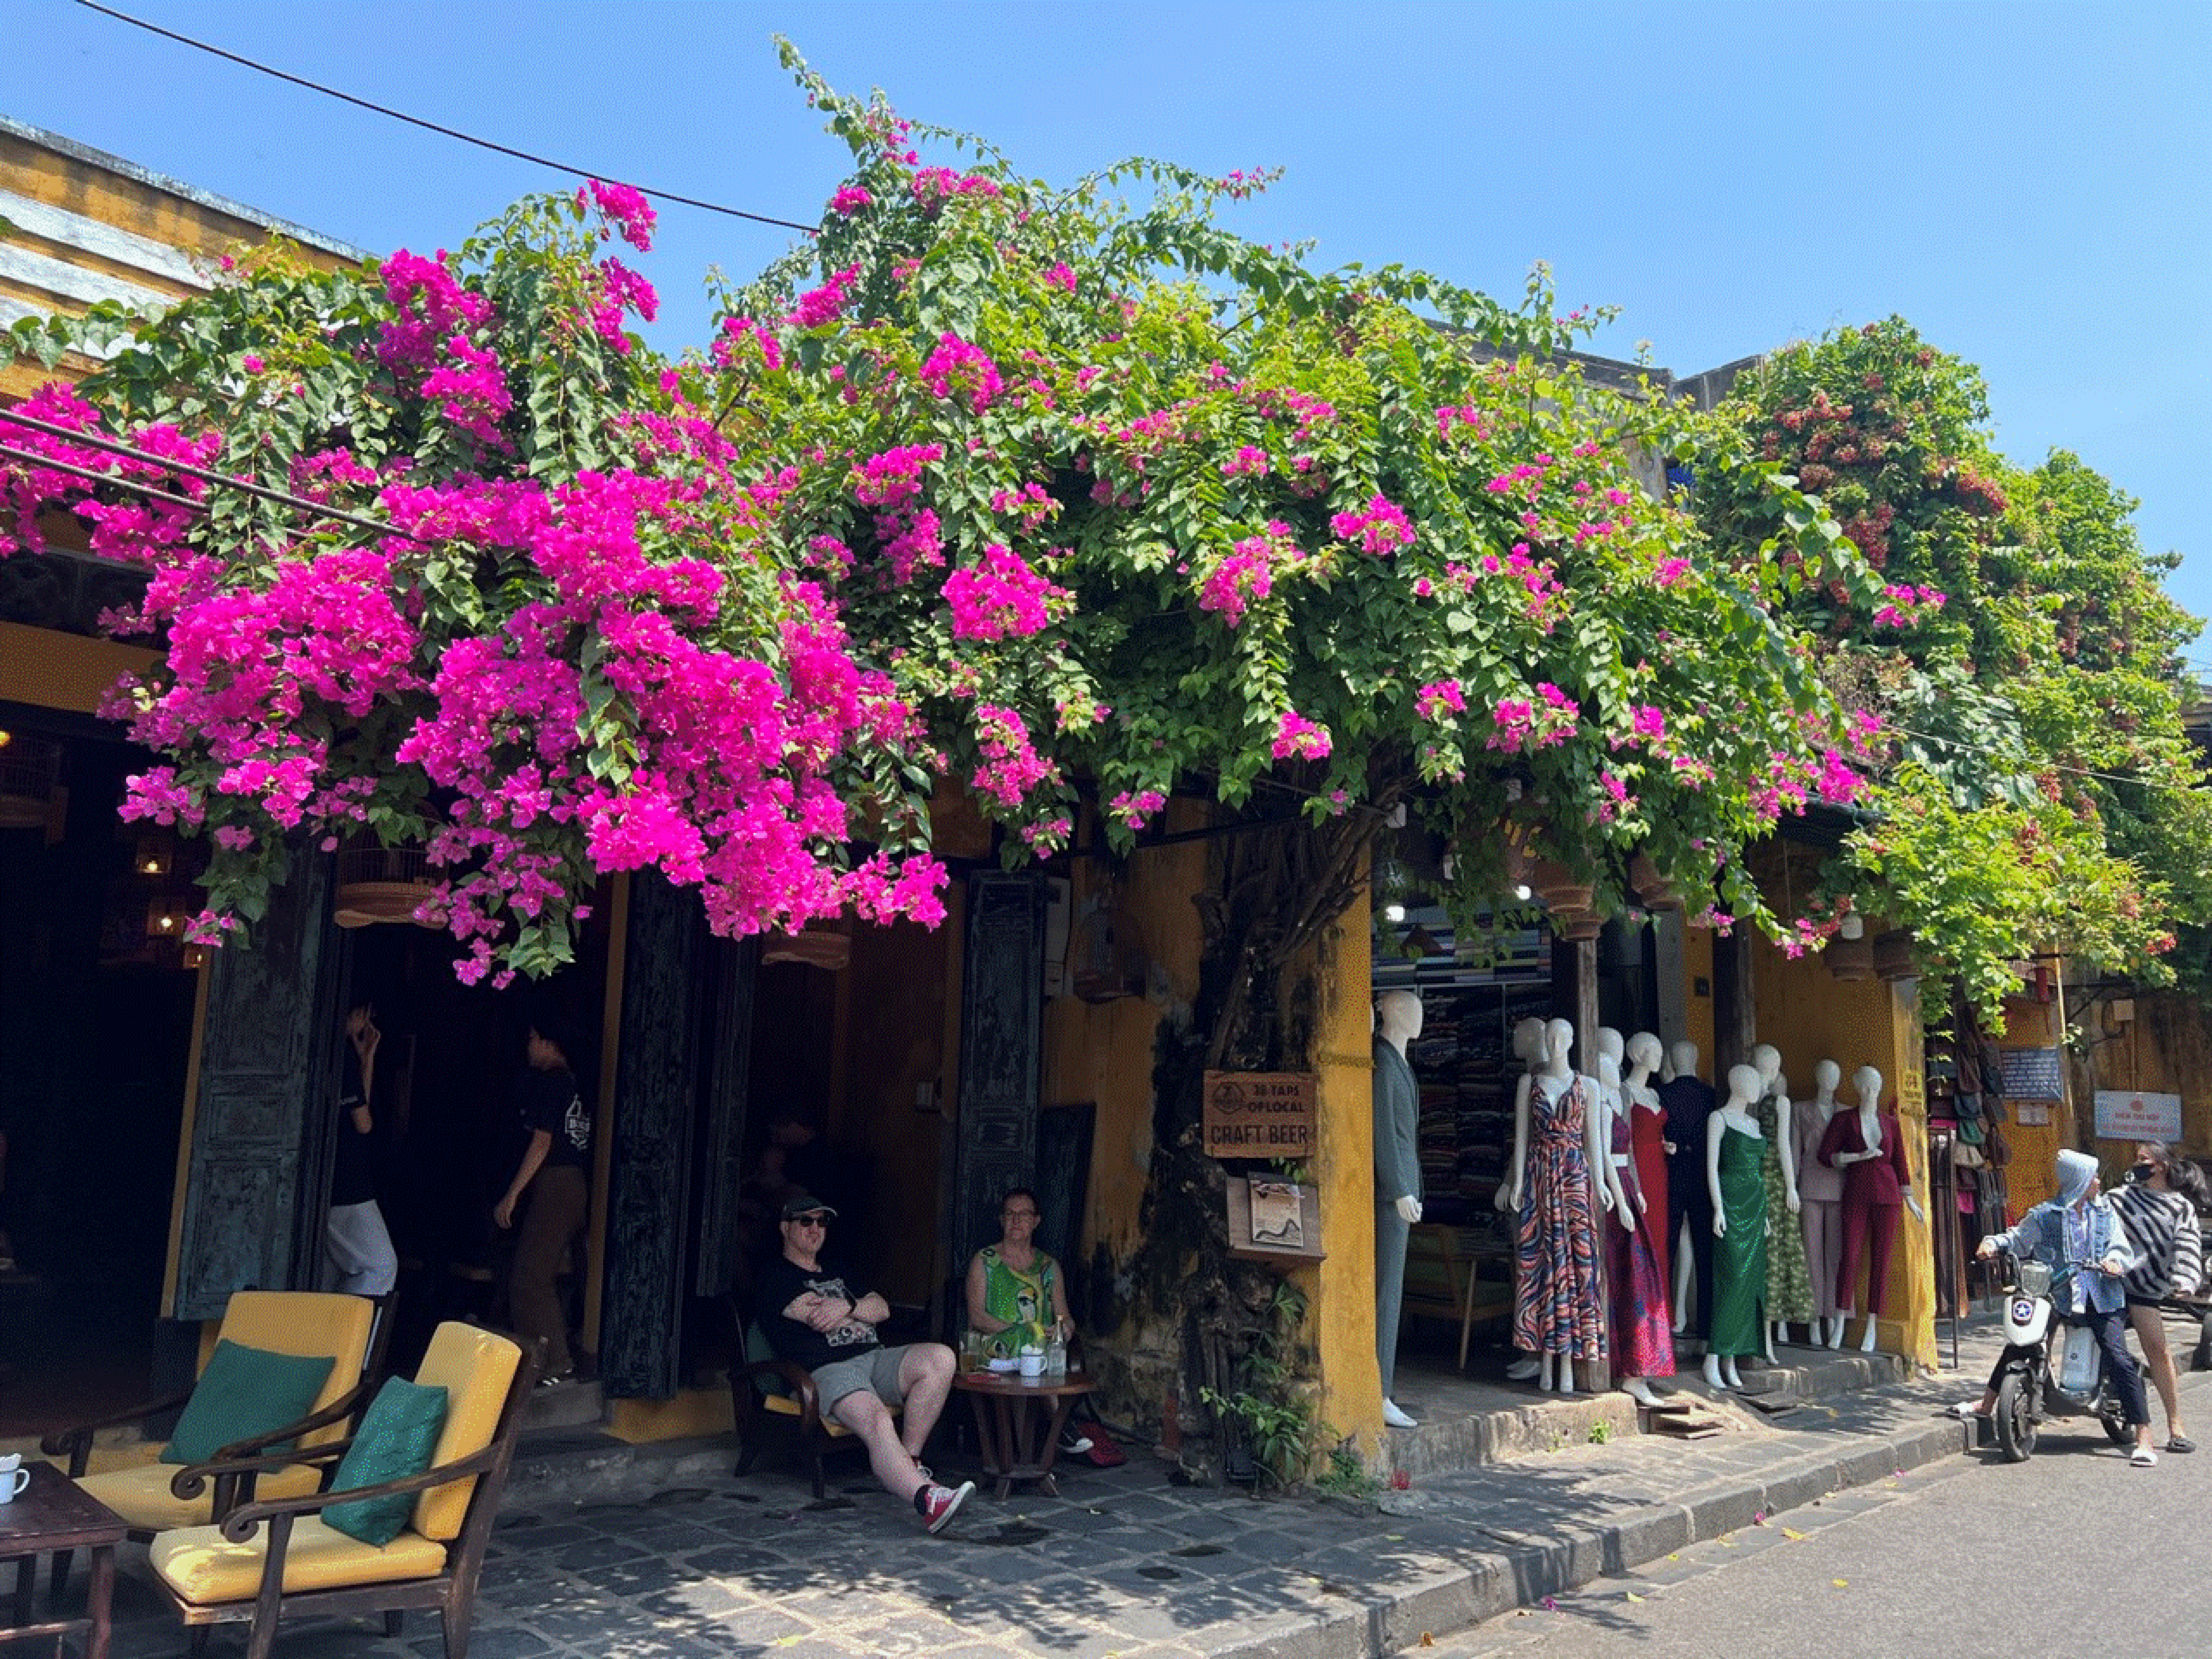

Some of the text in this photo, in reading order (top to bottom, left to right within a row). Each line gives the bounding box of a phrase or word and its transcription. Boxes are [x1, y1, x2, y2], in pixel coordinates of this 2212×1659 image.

[1271, 1085, 1300, 1096] TAPS
[1266, 1101, 1305, 1113] LOCAL
[1211, 1124, 1308, 1144] CRAFT BEER
